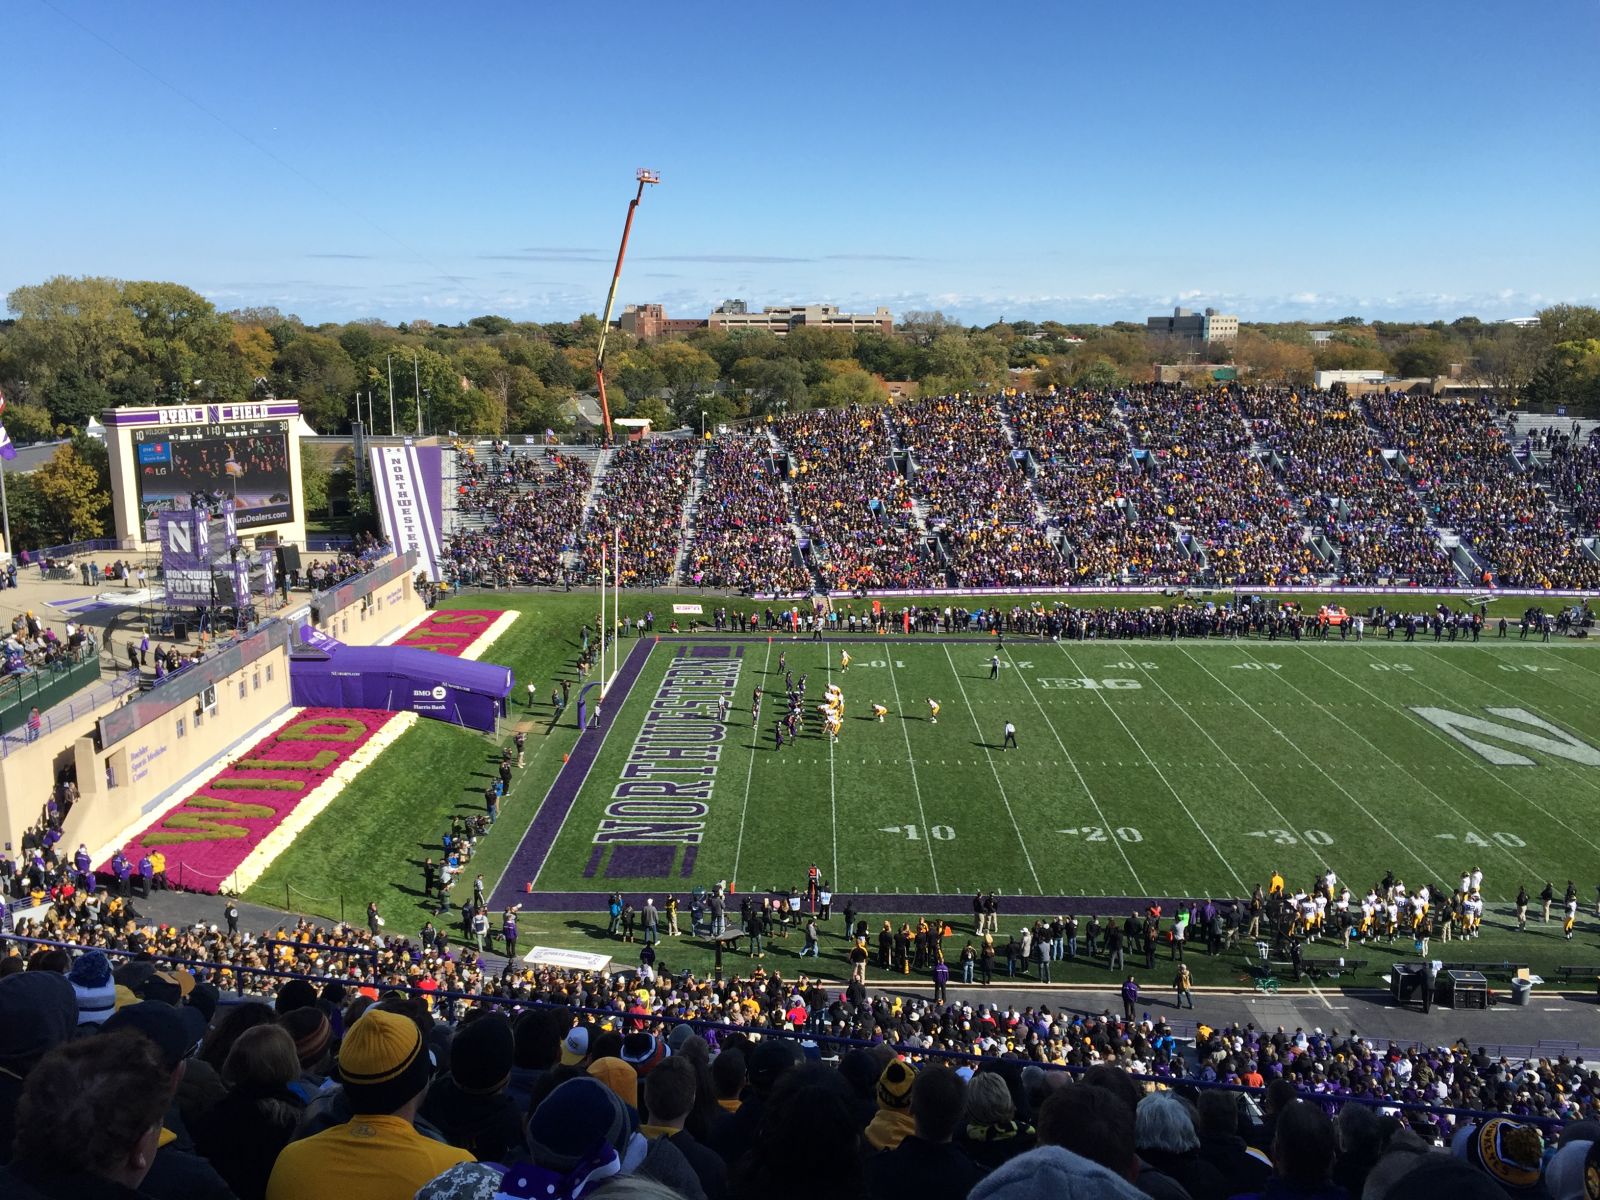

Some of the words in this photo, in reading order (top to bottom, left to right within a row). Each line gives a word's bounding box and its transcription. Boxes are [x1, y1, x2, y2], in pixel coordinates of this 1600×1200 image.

[159, 409, 196, 424] RYAN
[231, 405, 268, 420] FIELD
[155, 467, 167, 475] LG
[226, 512, 235, 536] N
[235, 511, 287, 524] uraDealers.com
[168, 520, 192, 553] N
[200, 521, 208, 545] N
[240, 571, 249, 595] N
[265, 561, 273, 584] N
[1406, 706, 1600, 767] N
[592, 657, 743, 844] NORTHWESTERN
[141, 717, 369, 848] WILD
[903, 824, 956, 841] 10
[1081, 826, 1144, 843] 20
[1267, 829, 1334, 846] 30
[1464, 831, 1527, 848] 40
